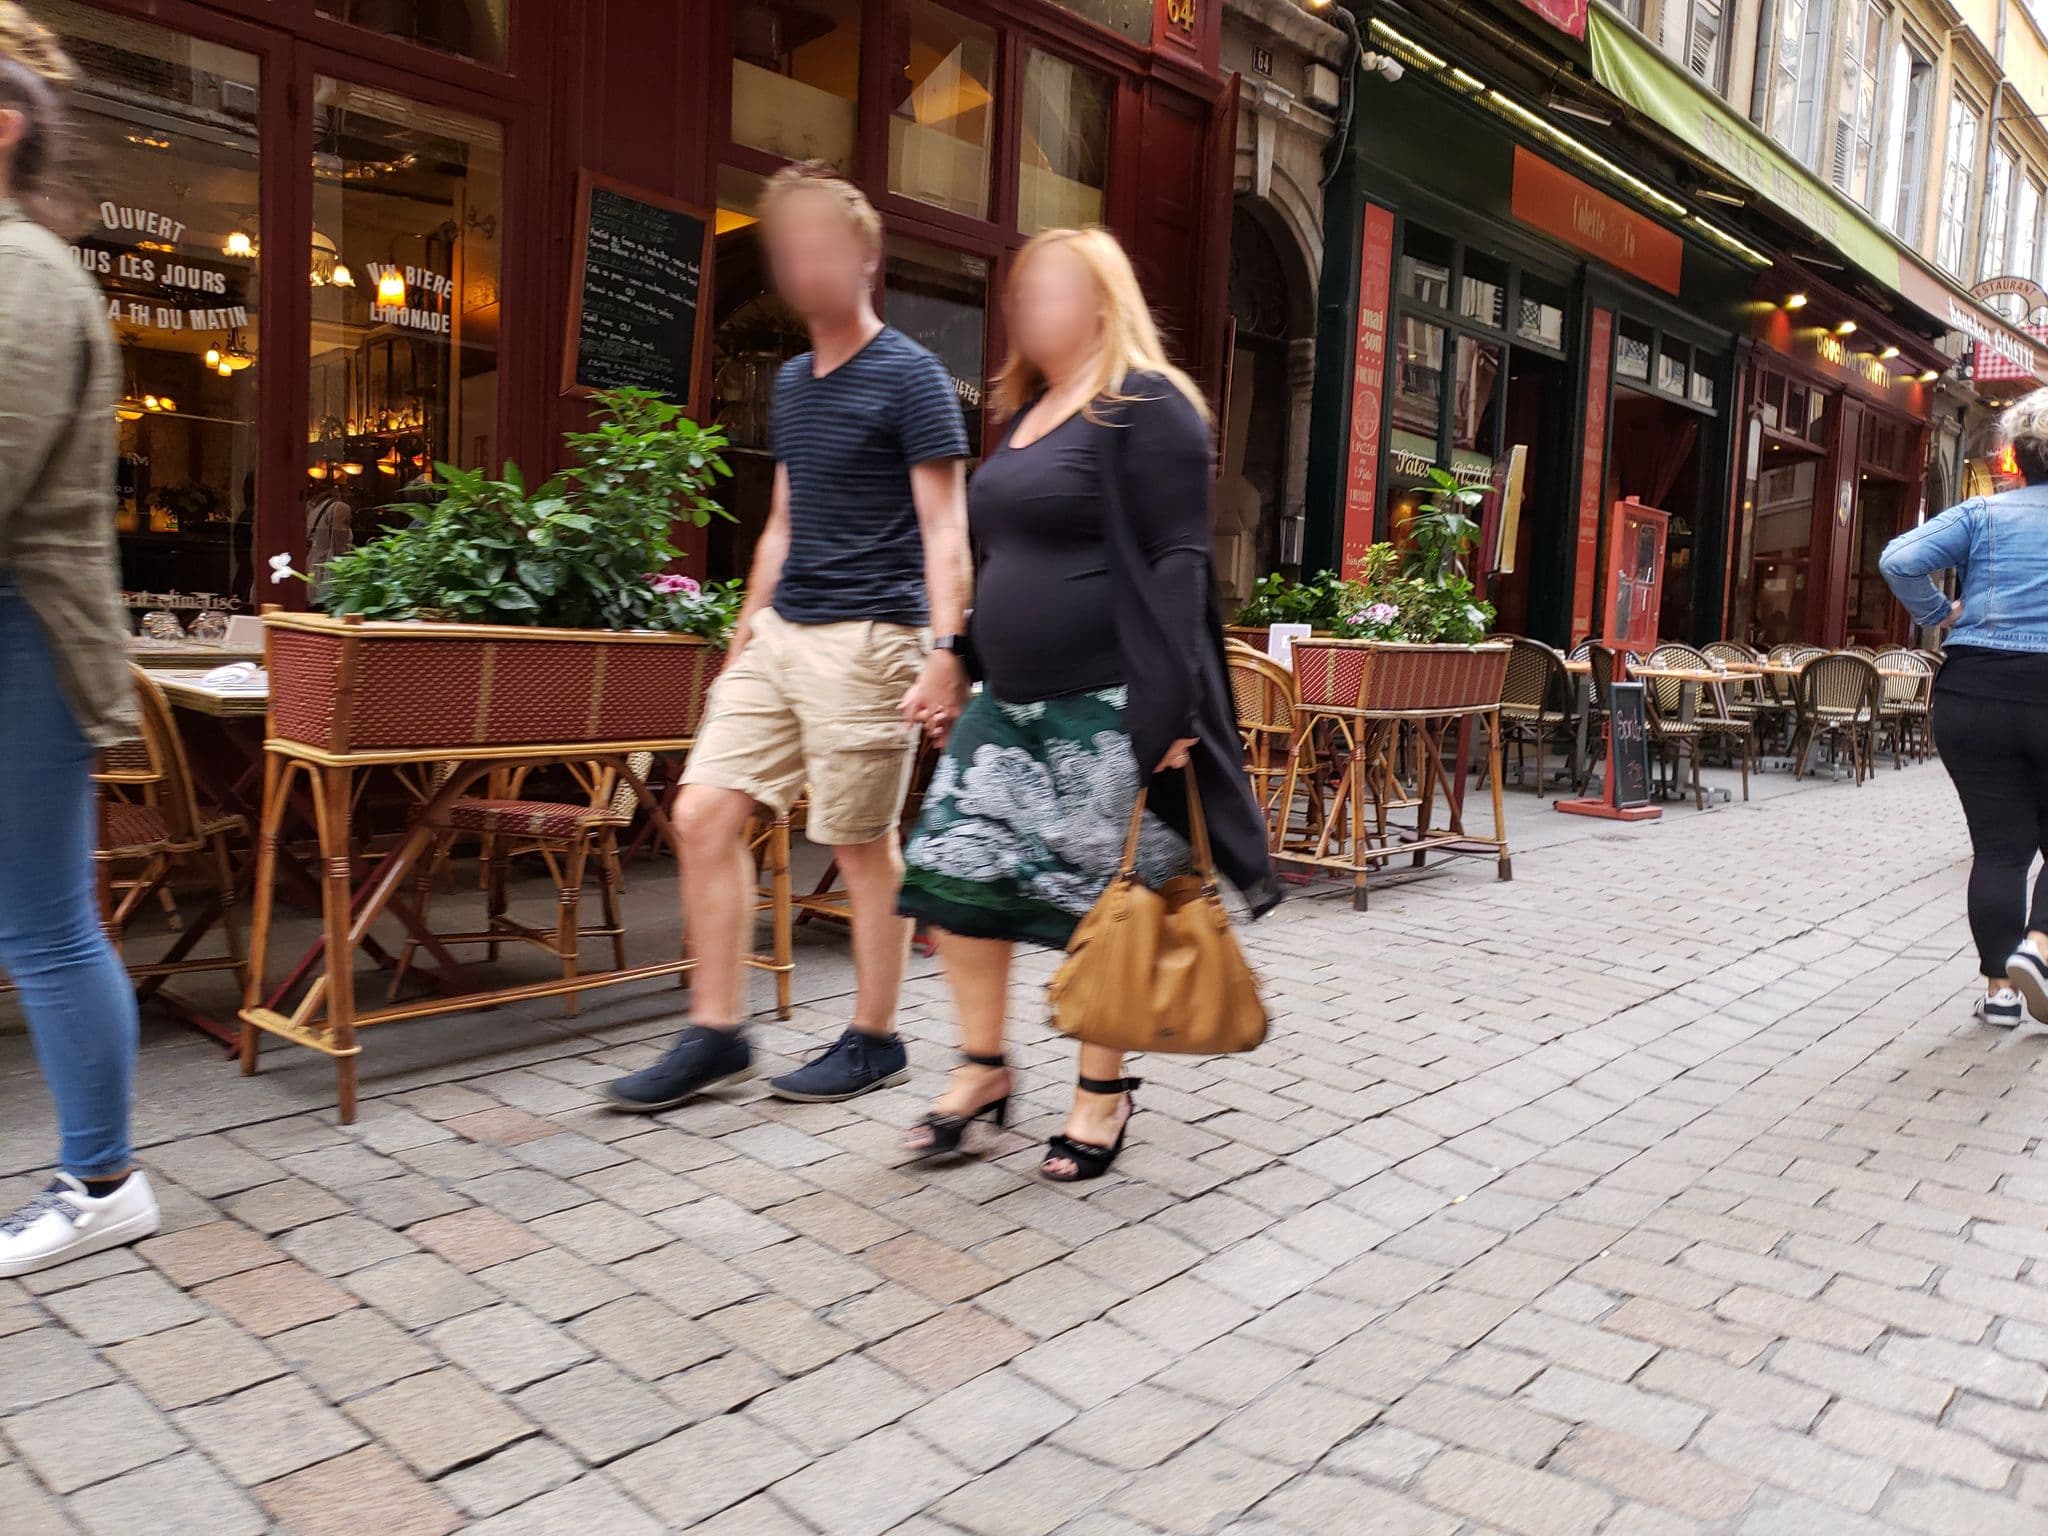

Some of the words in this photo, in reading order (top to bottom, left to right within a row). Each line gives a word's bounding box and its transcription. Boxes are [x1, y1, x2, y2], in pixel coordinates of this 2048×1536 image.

[1167, 0, 1196, 31] 64
[1257, 49, 1270, 73] 64
[100, 201, 186, 243] OUVERT
[119, 255, 156, 282] LES
[160, 263, 227, 294] JOURS
[1975, 280, 2037, 298] ESTAURANT
[156, 307, 184, 330] DU
[189, 306, 248, 331] MATIN
[369, 301, 450, 333] LIMONADE
